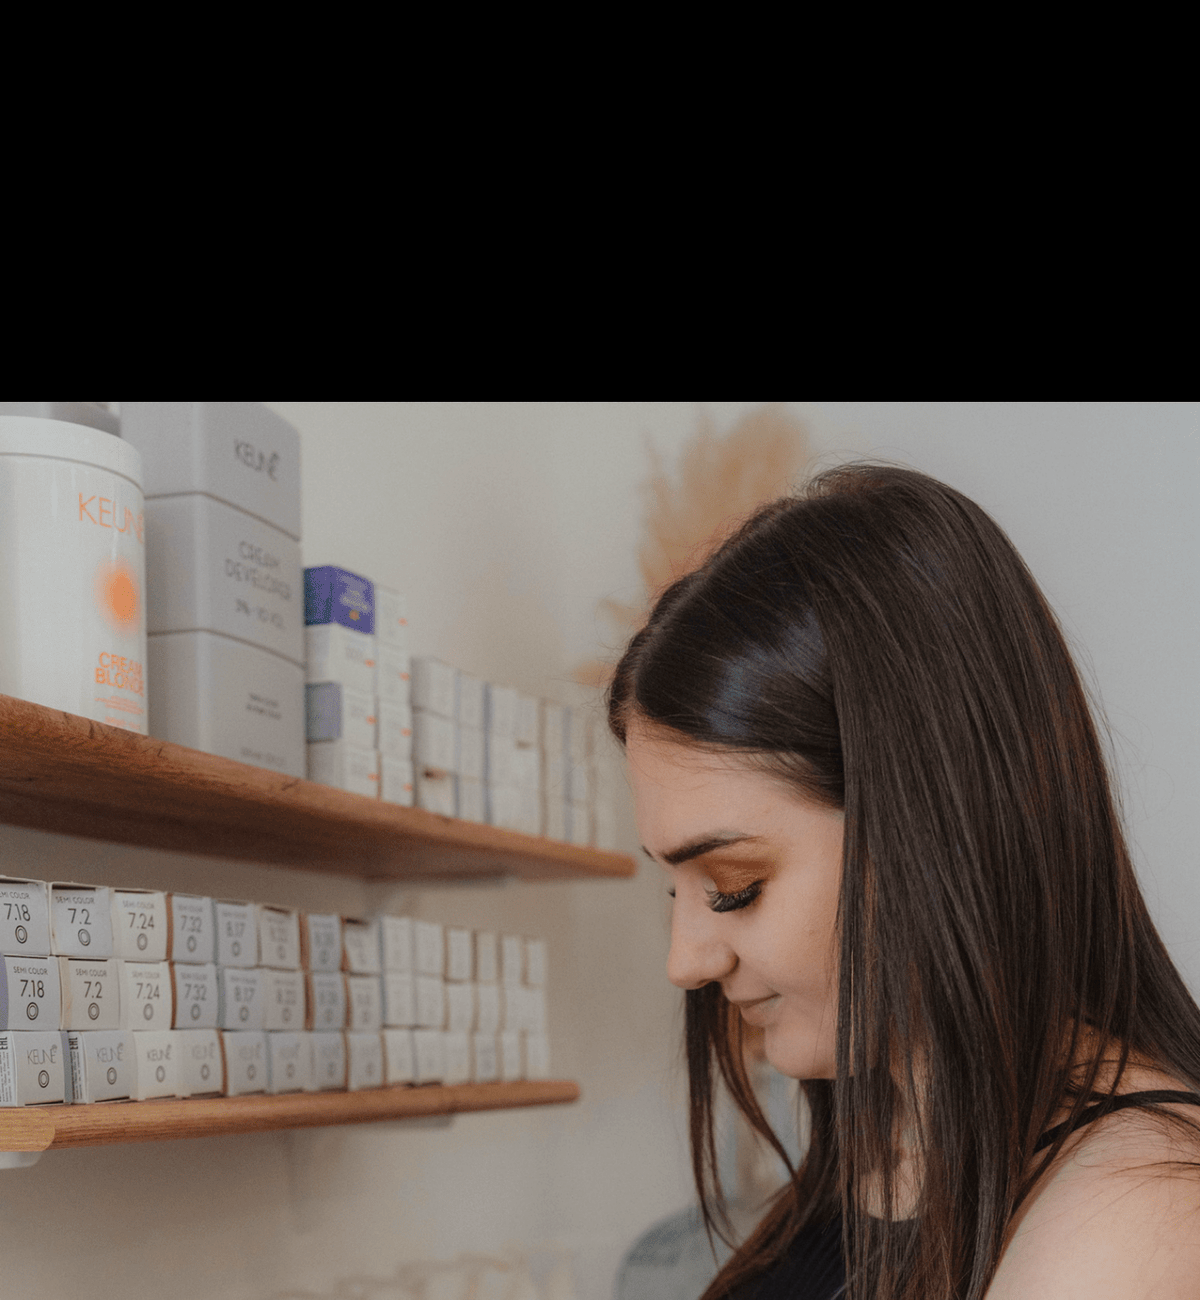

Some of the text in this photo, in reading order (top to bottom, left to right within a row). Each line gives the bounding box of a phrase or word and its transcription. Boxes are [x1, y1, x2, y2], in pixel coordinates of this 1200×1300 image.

[3, 903, 31, 922] 7.18
[67, 907, 92, 926] 7.2
[128, 912, 155, 930] 7.24
[13, 966, 49, 976] SEMI COLOR
[20, 979, 45, 998] 7.18
[84, 981, 103, 999] 7.2
[136, 982, 160, 1000] 7.24
[27, 1044, 58, 1065] KEUNE
